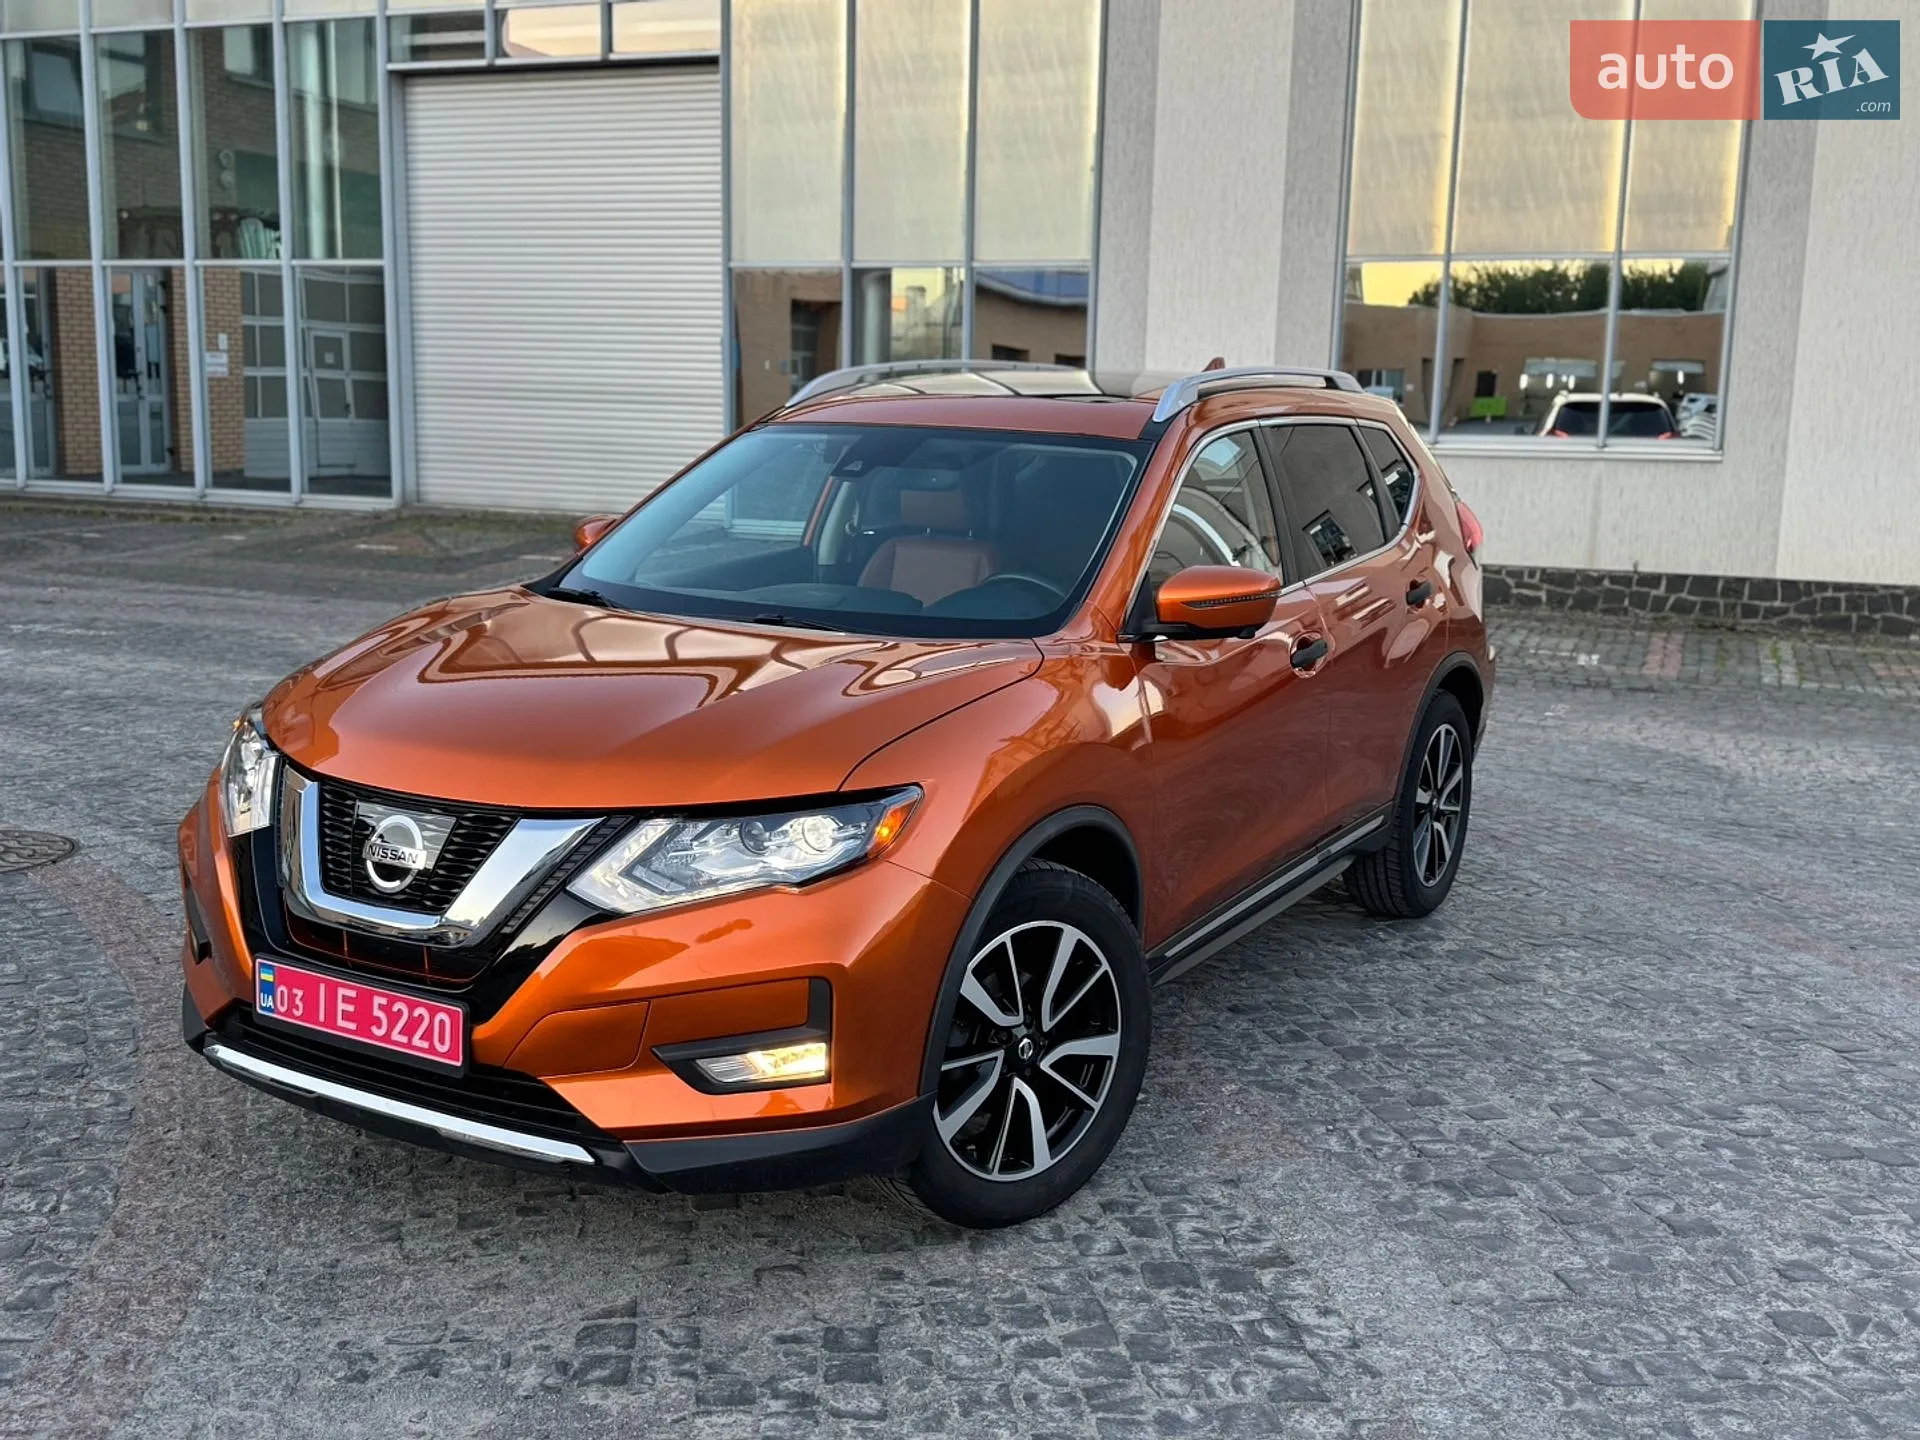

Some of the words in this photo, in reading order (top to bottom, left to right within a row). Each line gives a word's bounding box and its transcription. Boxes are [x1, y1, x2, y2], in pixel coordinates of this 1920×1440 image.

[368, 844, 419, 864] NISSAN
[260, 992, 274, 1009] UA
[277, 984, 304, 1017] 03
[318, 982, 358, 1031] IE
[370, 995, 451, 1053] 5220
